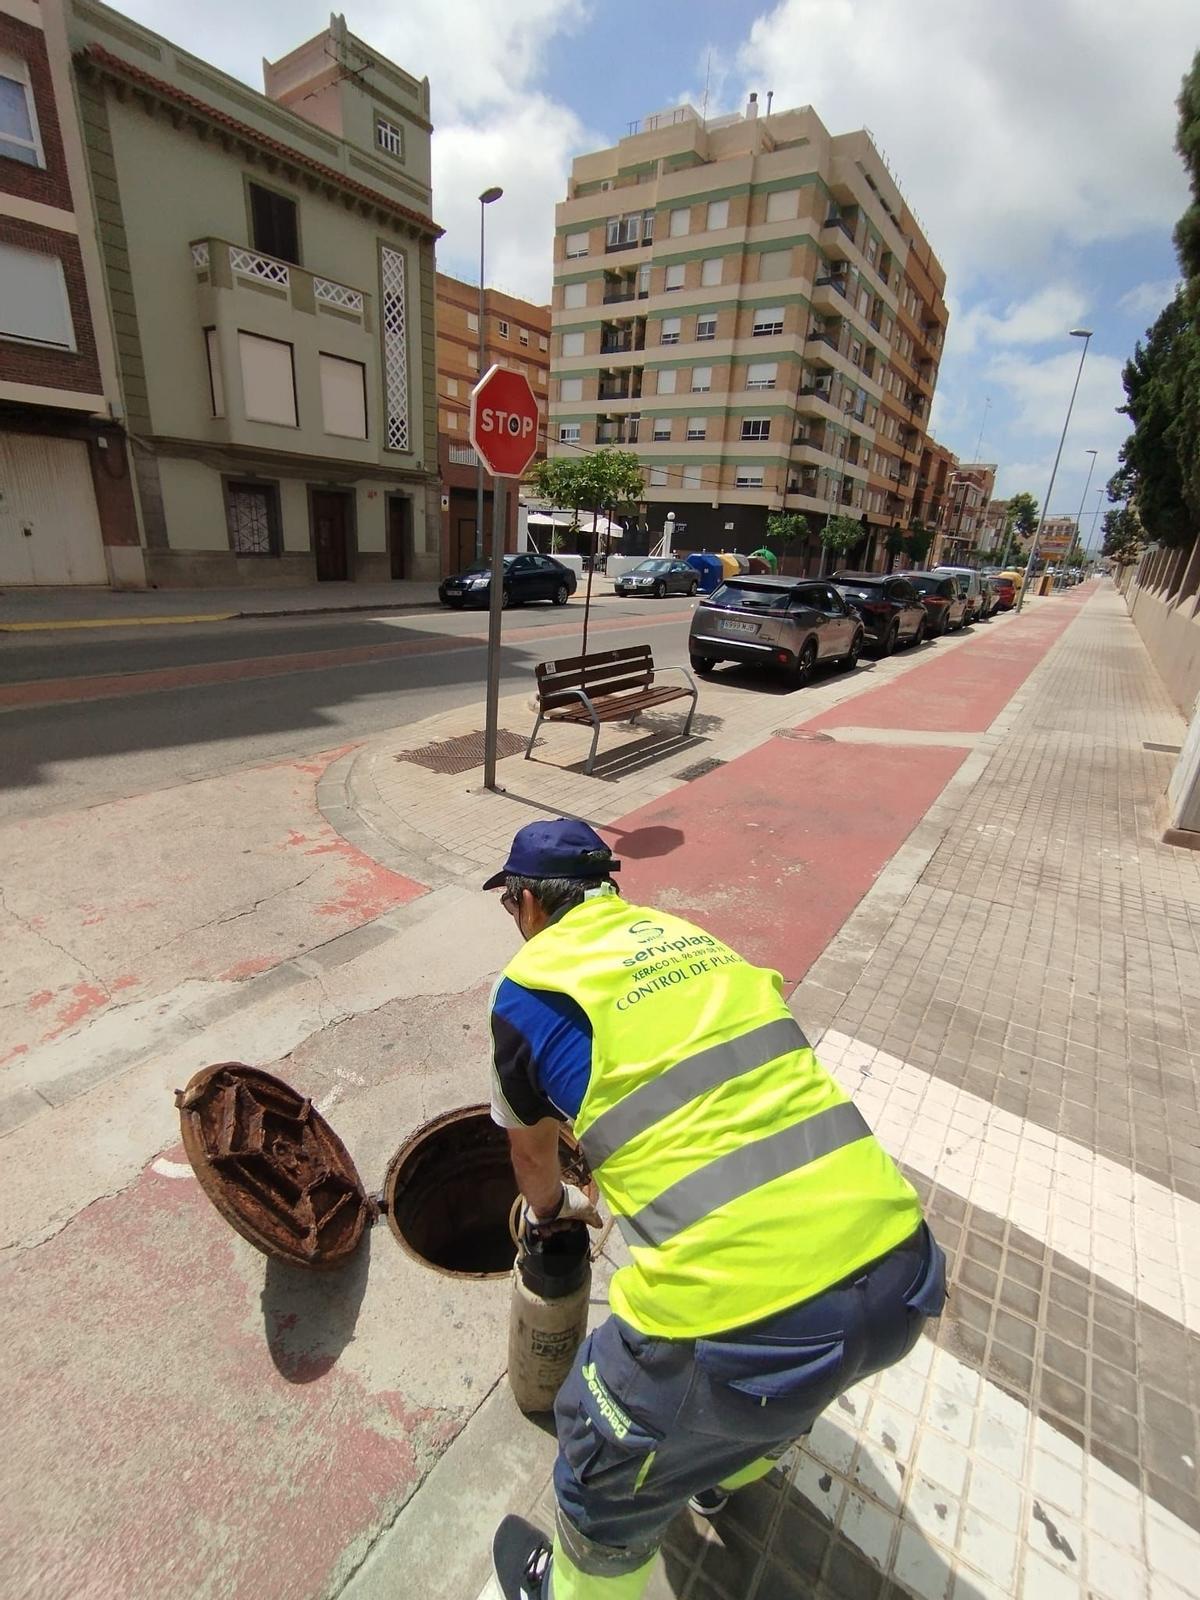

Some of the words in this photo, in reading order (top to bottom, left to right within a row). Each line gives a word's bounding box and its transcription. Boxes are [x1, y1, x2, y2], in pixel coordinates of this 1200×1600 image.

[481, 408, 534, 439] STOP
[622, 935, 716, 967] serviplag
[616, 968, 690, 1010] CONTROL
[689, 959, 711, 976] DE
[632, 959, 670, 982] XERACO
[581, 1362, 628, 1439] Serviplag
